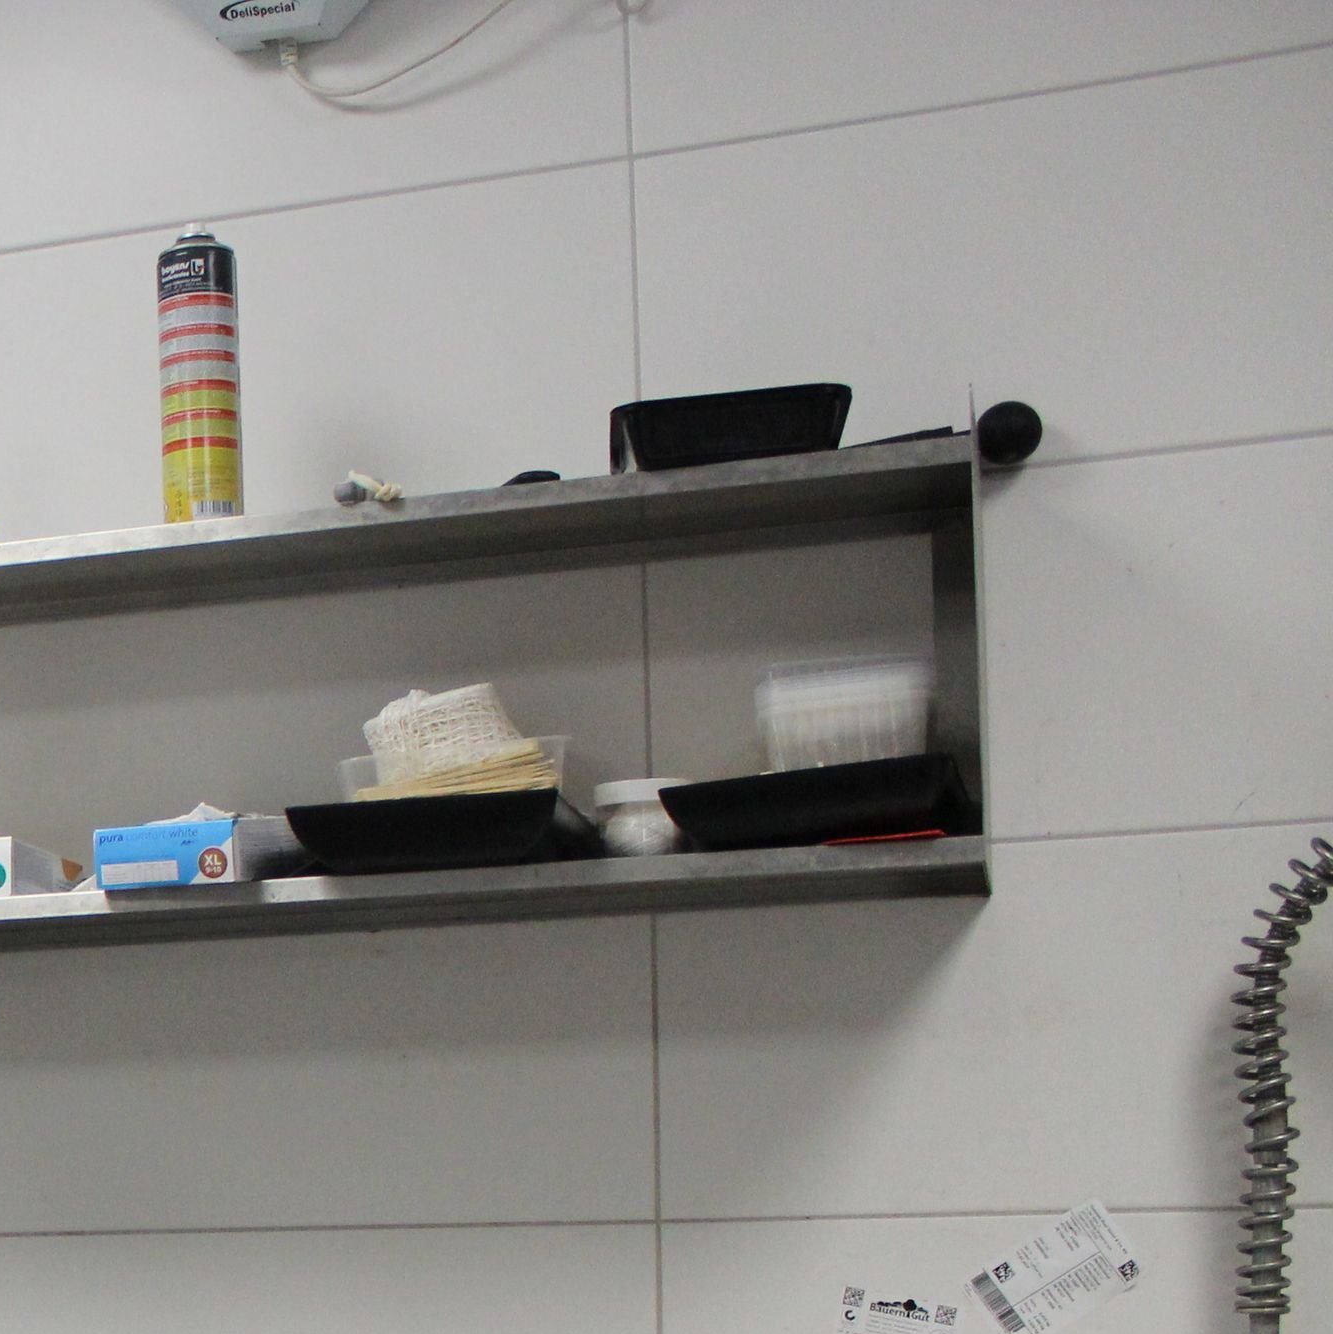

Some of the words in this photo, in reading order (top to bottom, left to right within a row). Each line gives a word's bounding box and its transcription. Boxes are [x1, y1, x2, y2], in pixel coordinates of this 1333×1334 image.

[230, 2, 295, 19] DeliSpecial
[99, 834, 123, 846] pura
[169, 825, 198, 838] white
[205, 854, 221, 866] XL
[870, 1303, 907, 1318] Bauern
[911, 1311, 931, 1322] Gut
